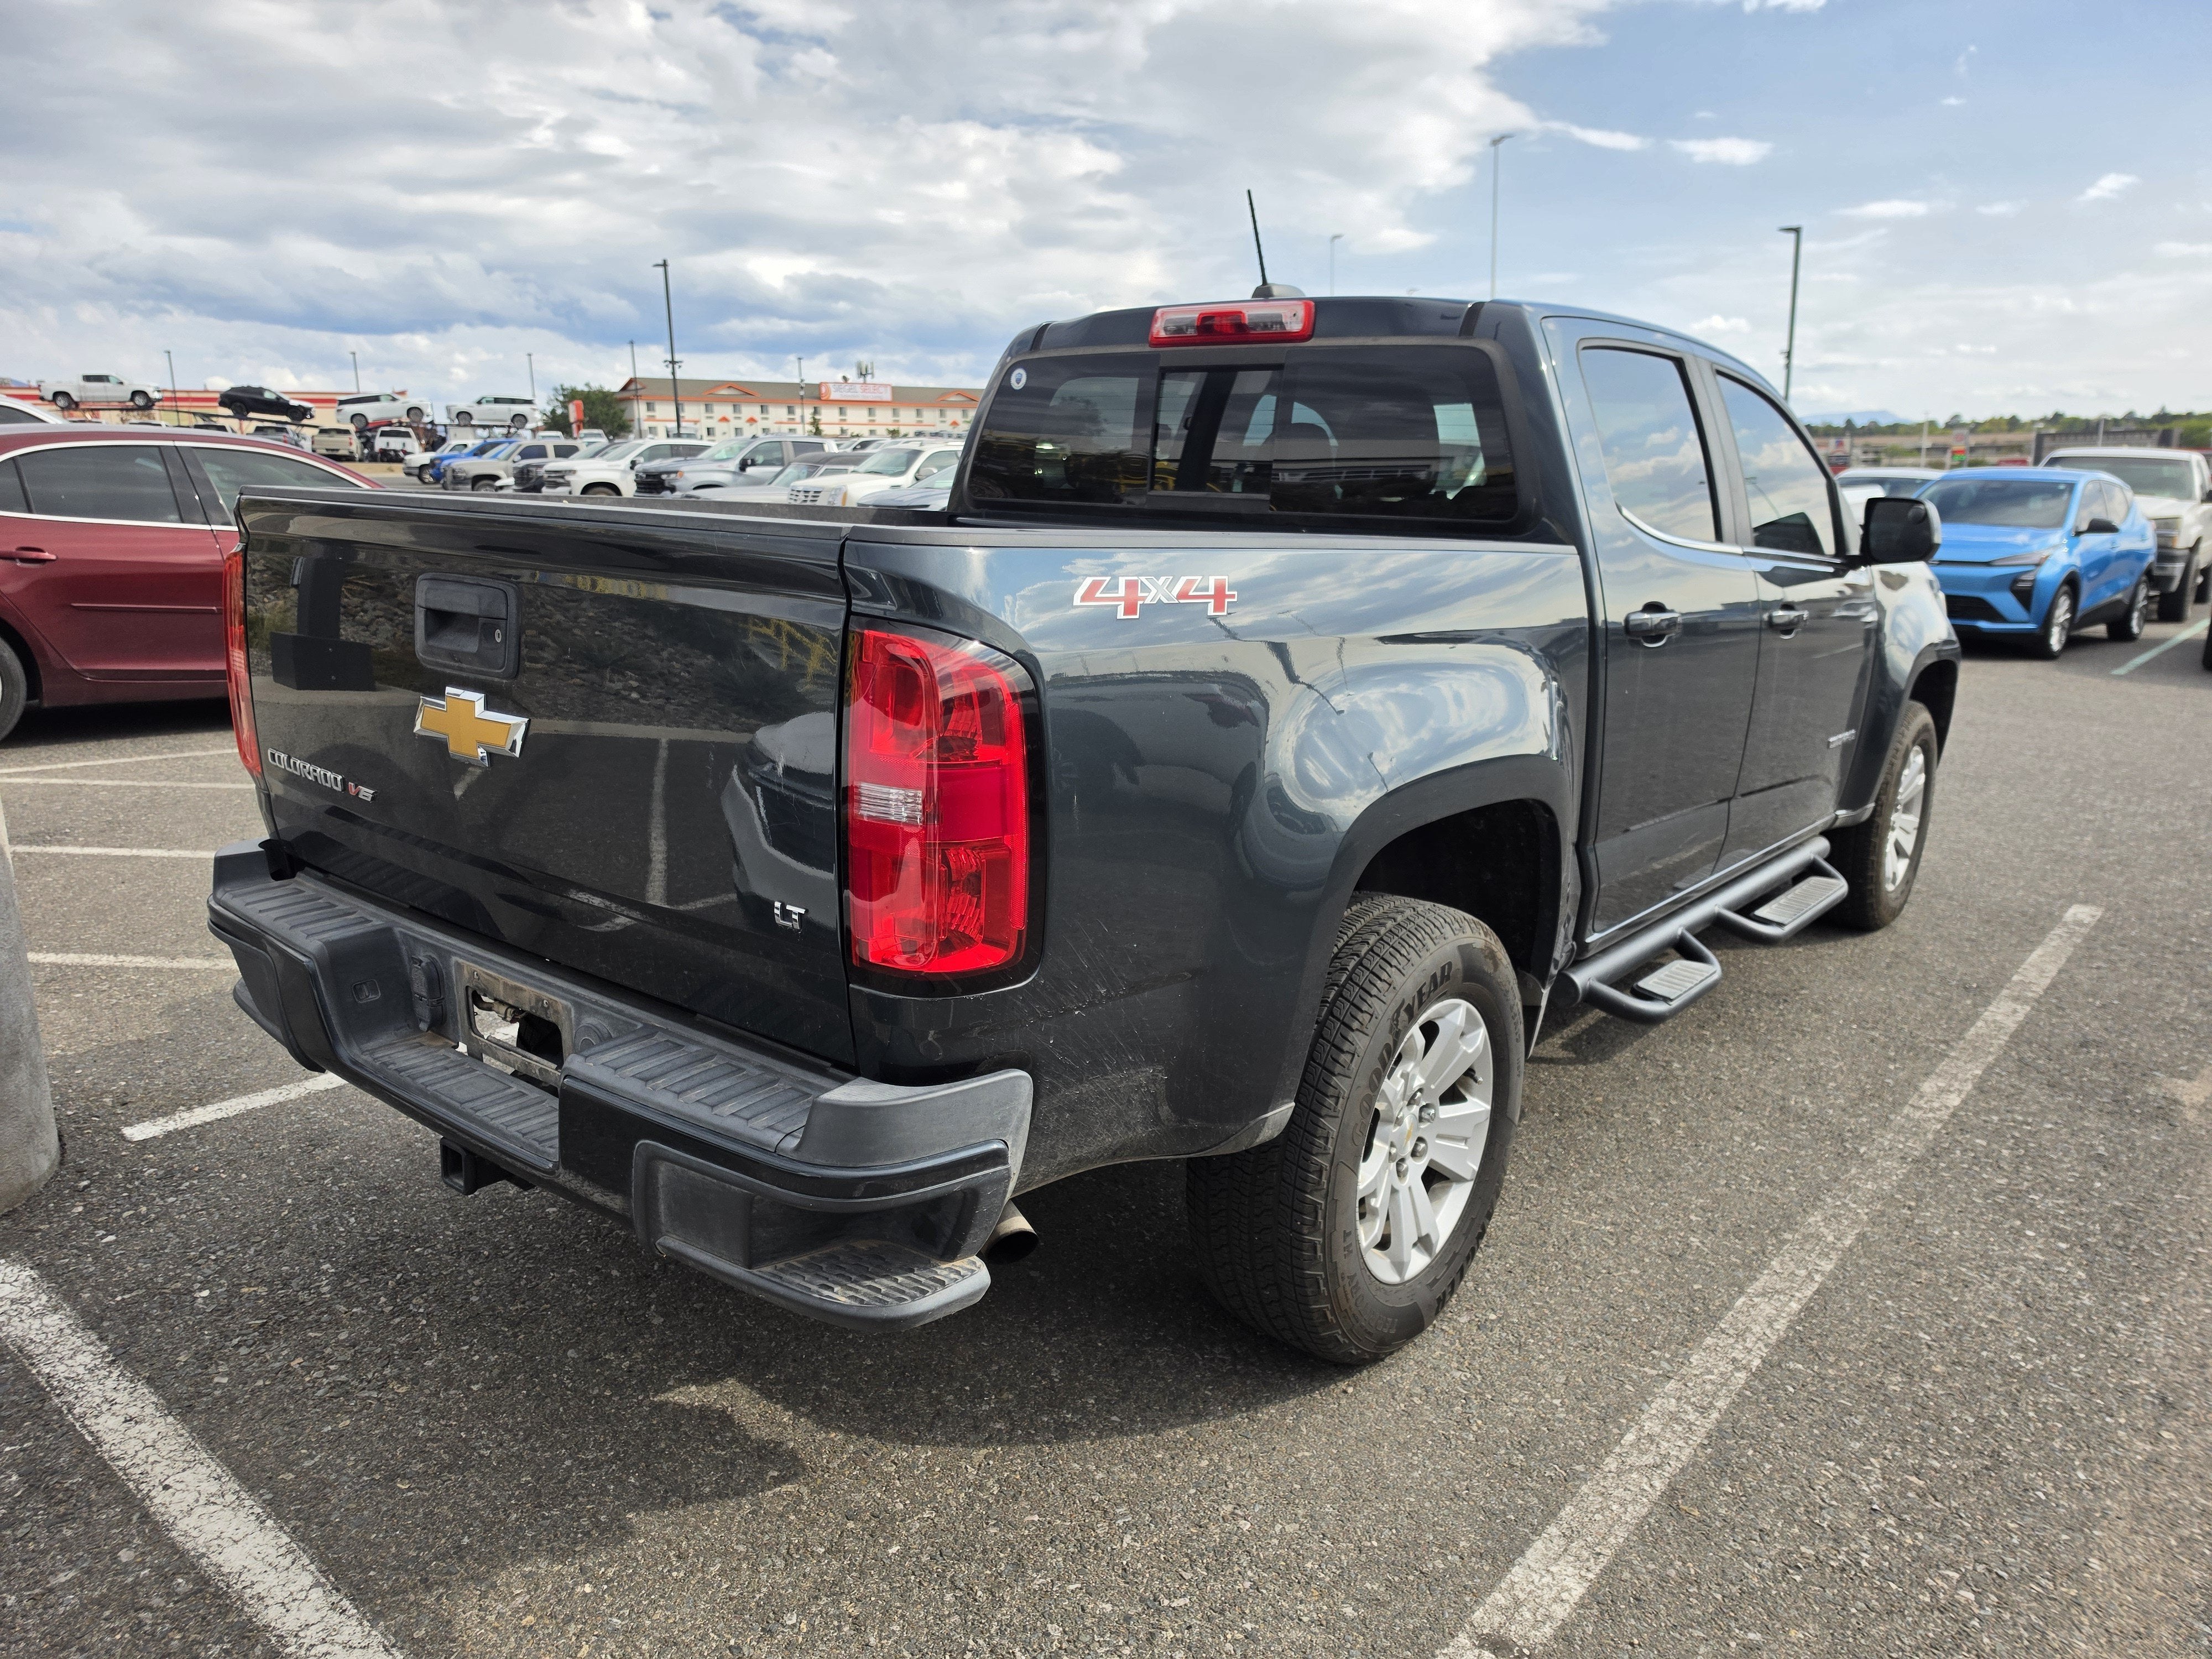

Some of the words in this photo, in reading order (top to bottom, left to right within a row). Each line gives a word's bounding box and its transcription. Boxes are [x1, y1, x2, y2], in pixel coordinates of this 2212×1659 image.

[268, 748, 344, 792] COLORADO
[348, 781, 377, 802] V6
[774, 900, 807, 930] LT
[1352, 961, 1453, 1146] GOODYEAR
